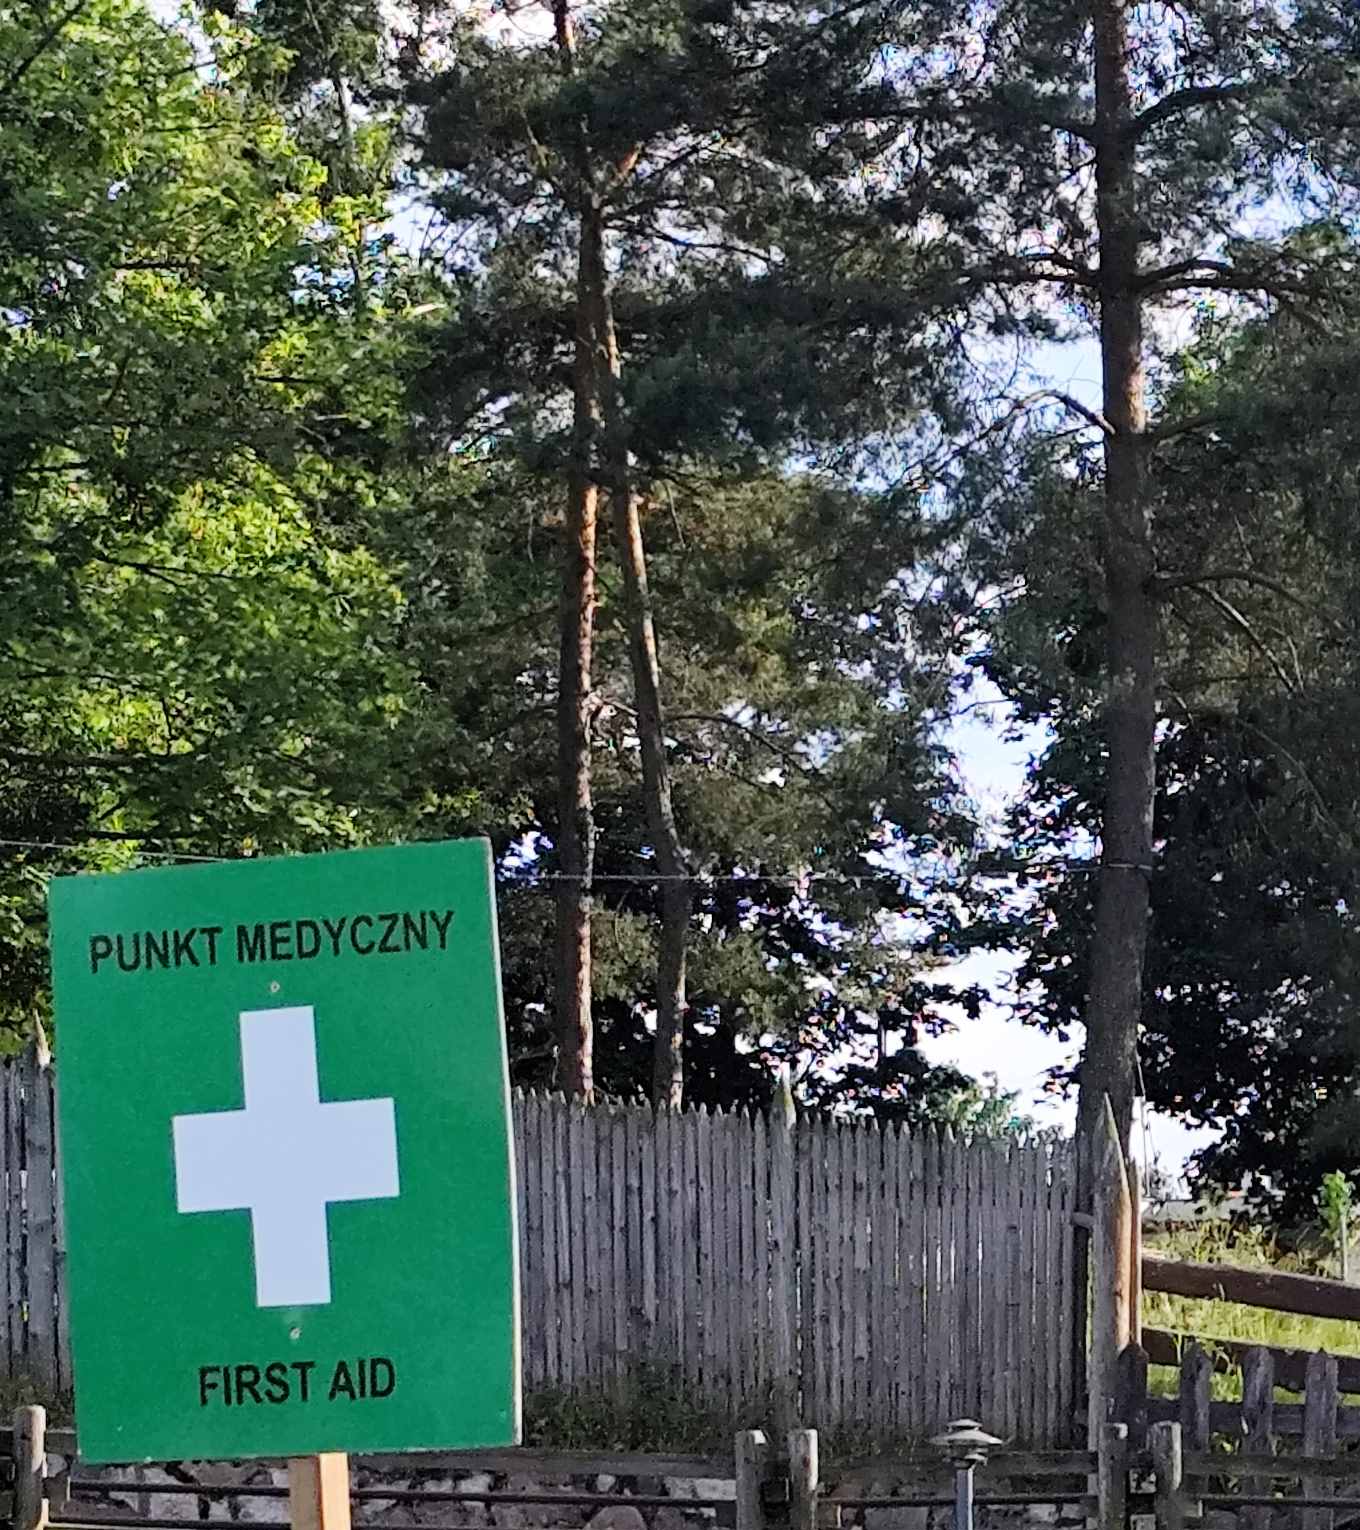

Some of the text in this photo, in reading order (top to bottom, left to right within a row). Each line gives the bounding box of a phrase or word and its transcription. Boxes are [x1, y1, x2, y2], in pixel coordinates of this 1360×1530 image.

[89, 909, 457, 974] PUNKT MEDYCZNY
[198, 1357, 397, 1407] FIRST AID
